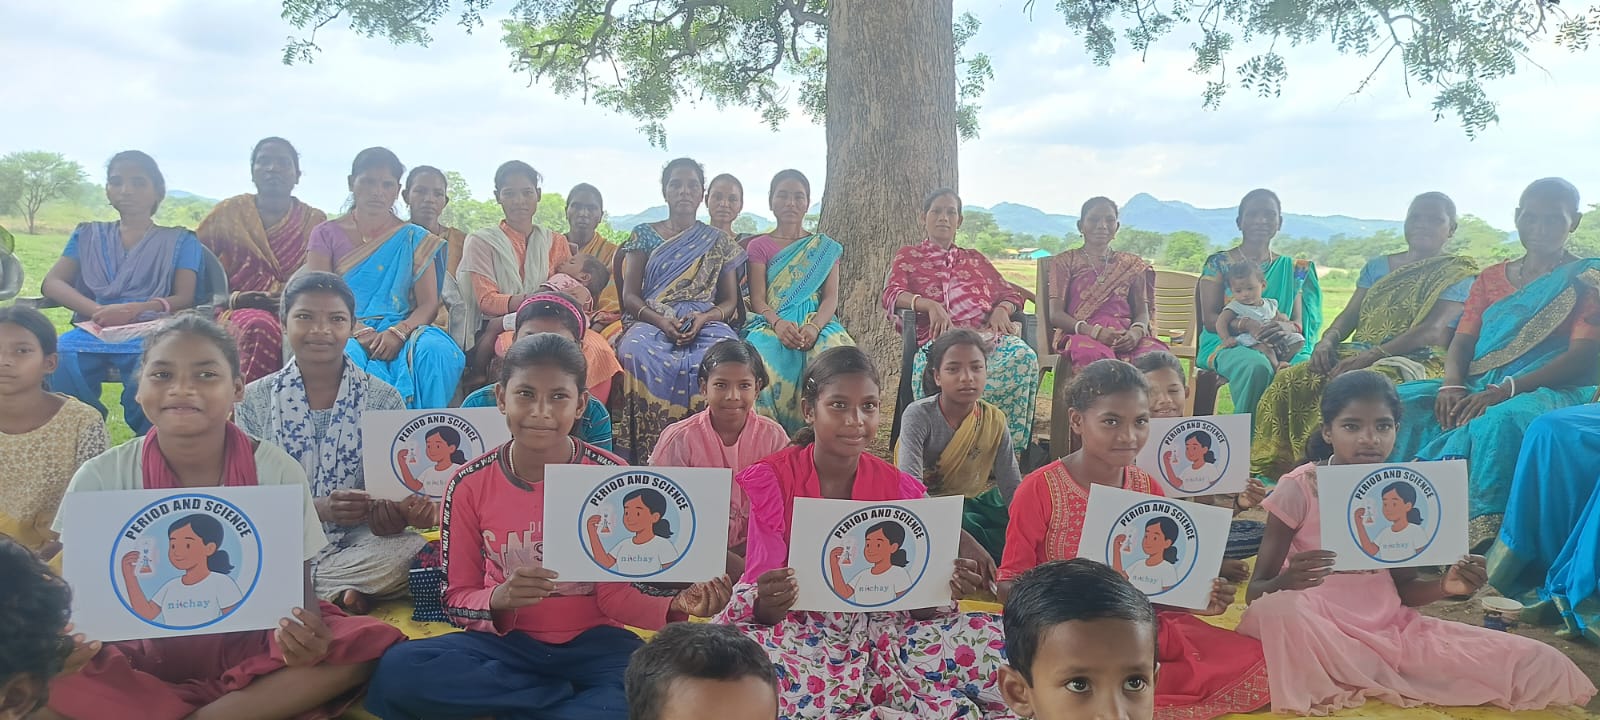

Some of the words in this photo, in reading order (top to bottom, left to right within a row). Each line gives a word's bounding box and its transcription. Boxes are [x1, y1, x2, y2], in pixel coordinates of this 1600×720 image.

[398, 419, 426, 442] PERIOD
[427, 415, 446, 424] AND
[447, 416, 478, 442] SCIENCE
[589, 479, 626, 507] PERIOD
[627, 474, 650, 486] AND
[651, 477, 689, 511] SCIENCE
[1354, 475, 1383, 501] PERIOD
[1383, 470, 1402, 480] AND
[1403, 471, 1434, 500] SCIENCE
[124, 502, 171, 541] PERIOD
[173, 498, 201, 512] AND
[204, 499, 252, 539] SCIENCE
[834, 512, 869, 540] PERIOD
[870, 508, 892, 519] AND
[892, 510, 925, 540] SCIENCE
[1120, 504, 1151, 527] PERIOD
[1152, 503, 1171, 515] AND
[1170, 508, 1195, 541] SCIENCE
